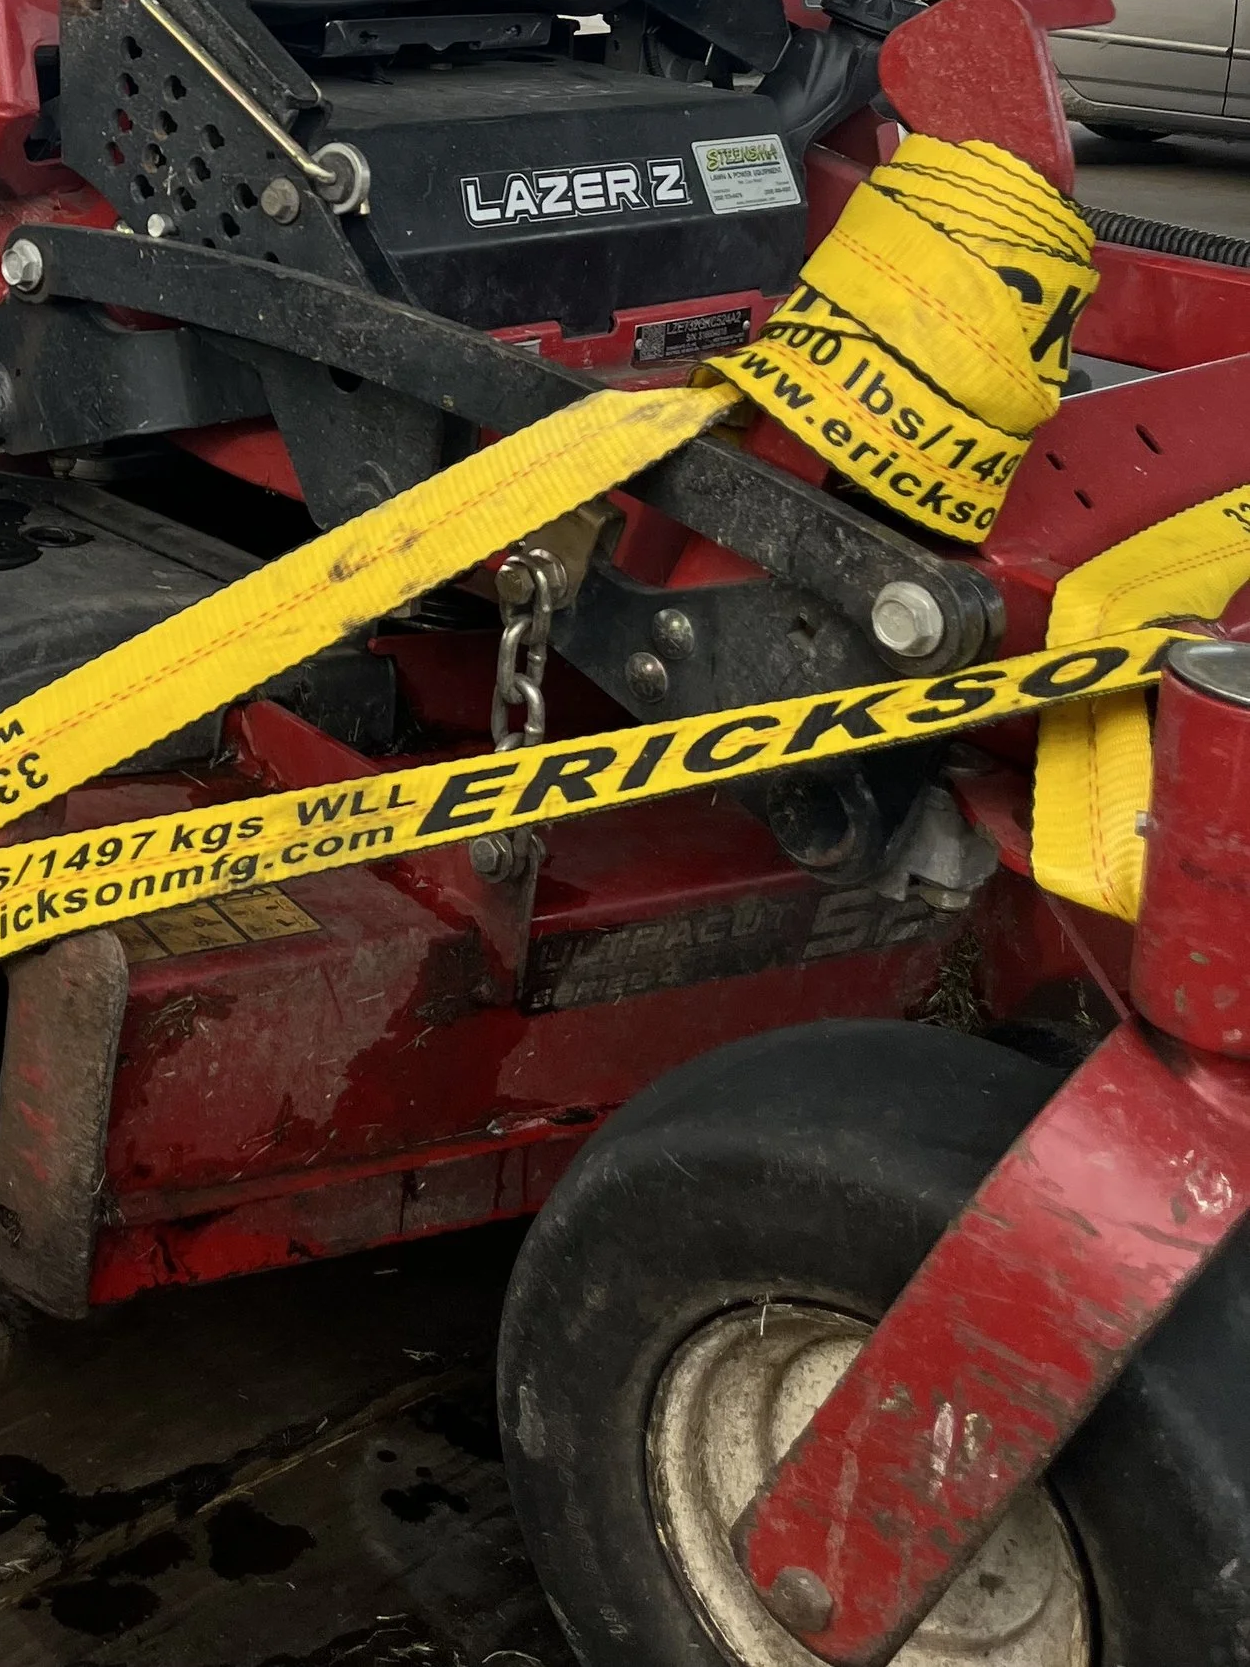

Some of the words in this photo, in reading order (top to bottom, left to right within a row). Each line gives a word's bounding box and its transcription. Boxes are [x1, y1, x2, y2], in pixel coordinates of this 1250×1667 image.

[706, 143, 778, 172] STEENSMA
[463, 163, 647, 226] LAZER
[649, 161, 689, 205] Z
[170, 814, 264, 856] kgs
[295, 783, 417, 828] WLL
